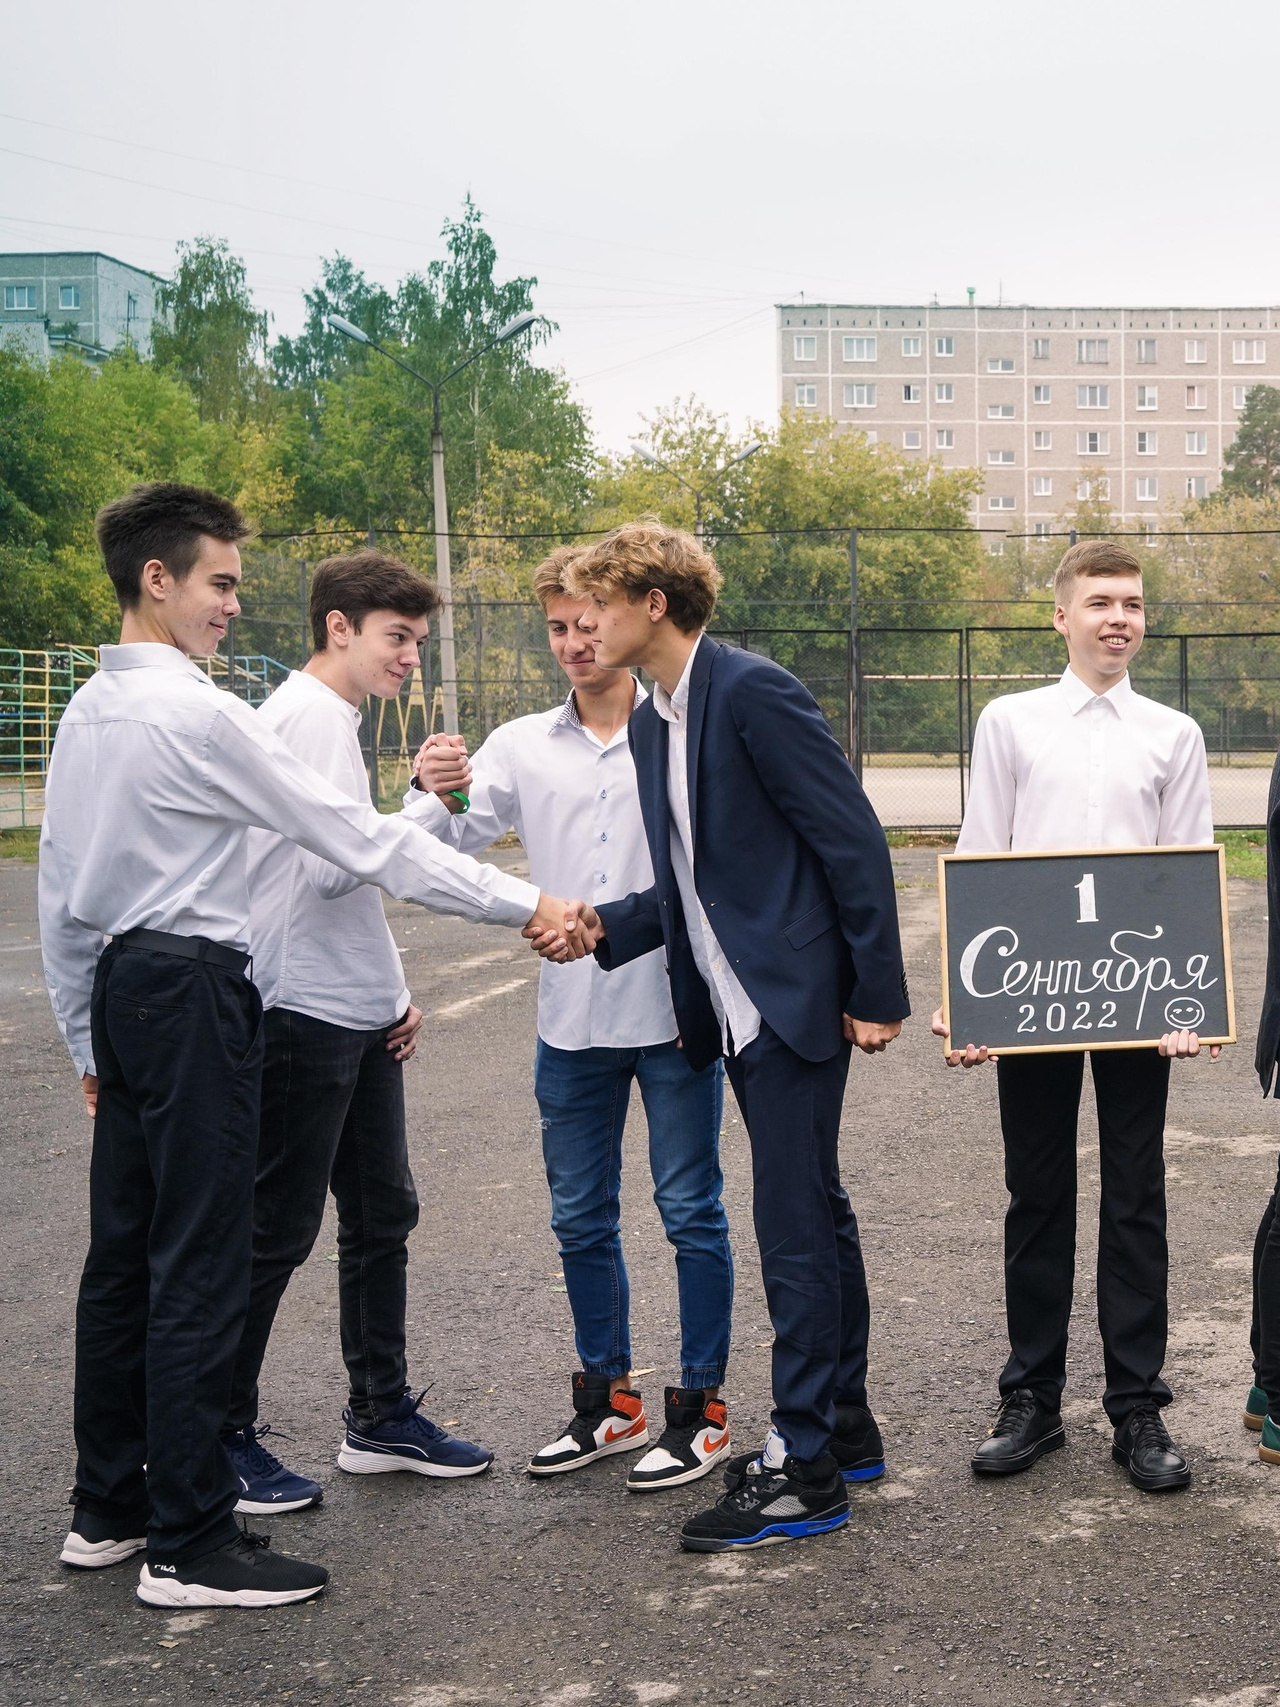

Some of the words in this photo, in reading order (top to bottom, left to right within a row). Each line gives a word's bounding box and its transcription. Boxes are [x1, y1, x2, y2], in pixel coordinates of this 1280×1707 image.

[1074, 873, 1099, 923] 1
[960, 925, 1218, 1030] Сентября
[1016, 1001, 1117, 1033] 2022
